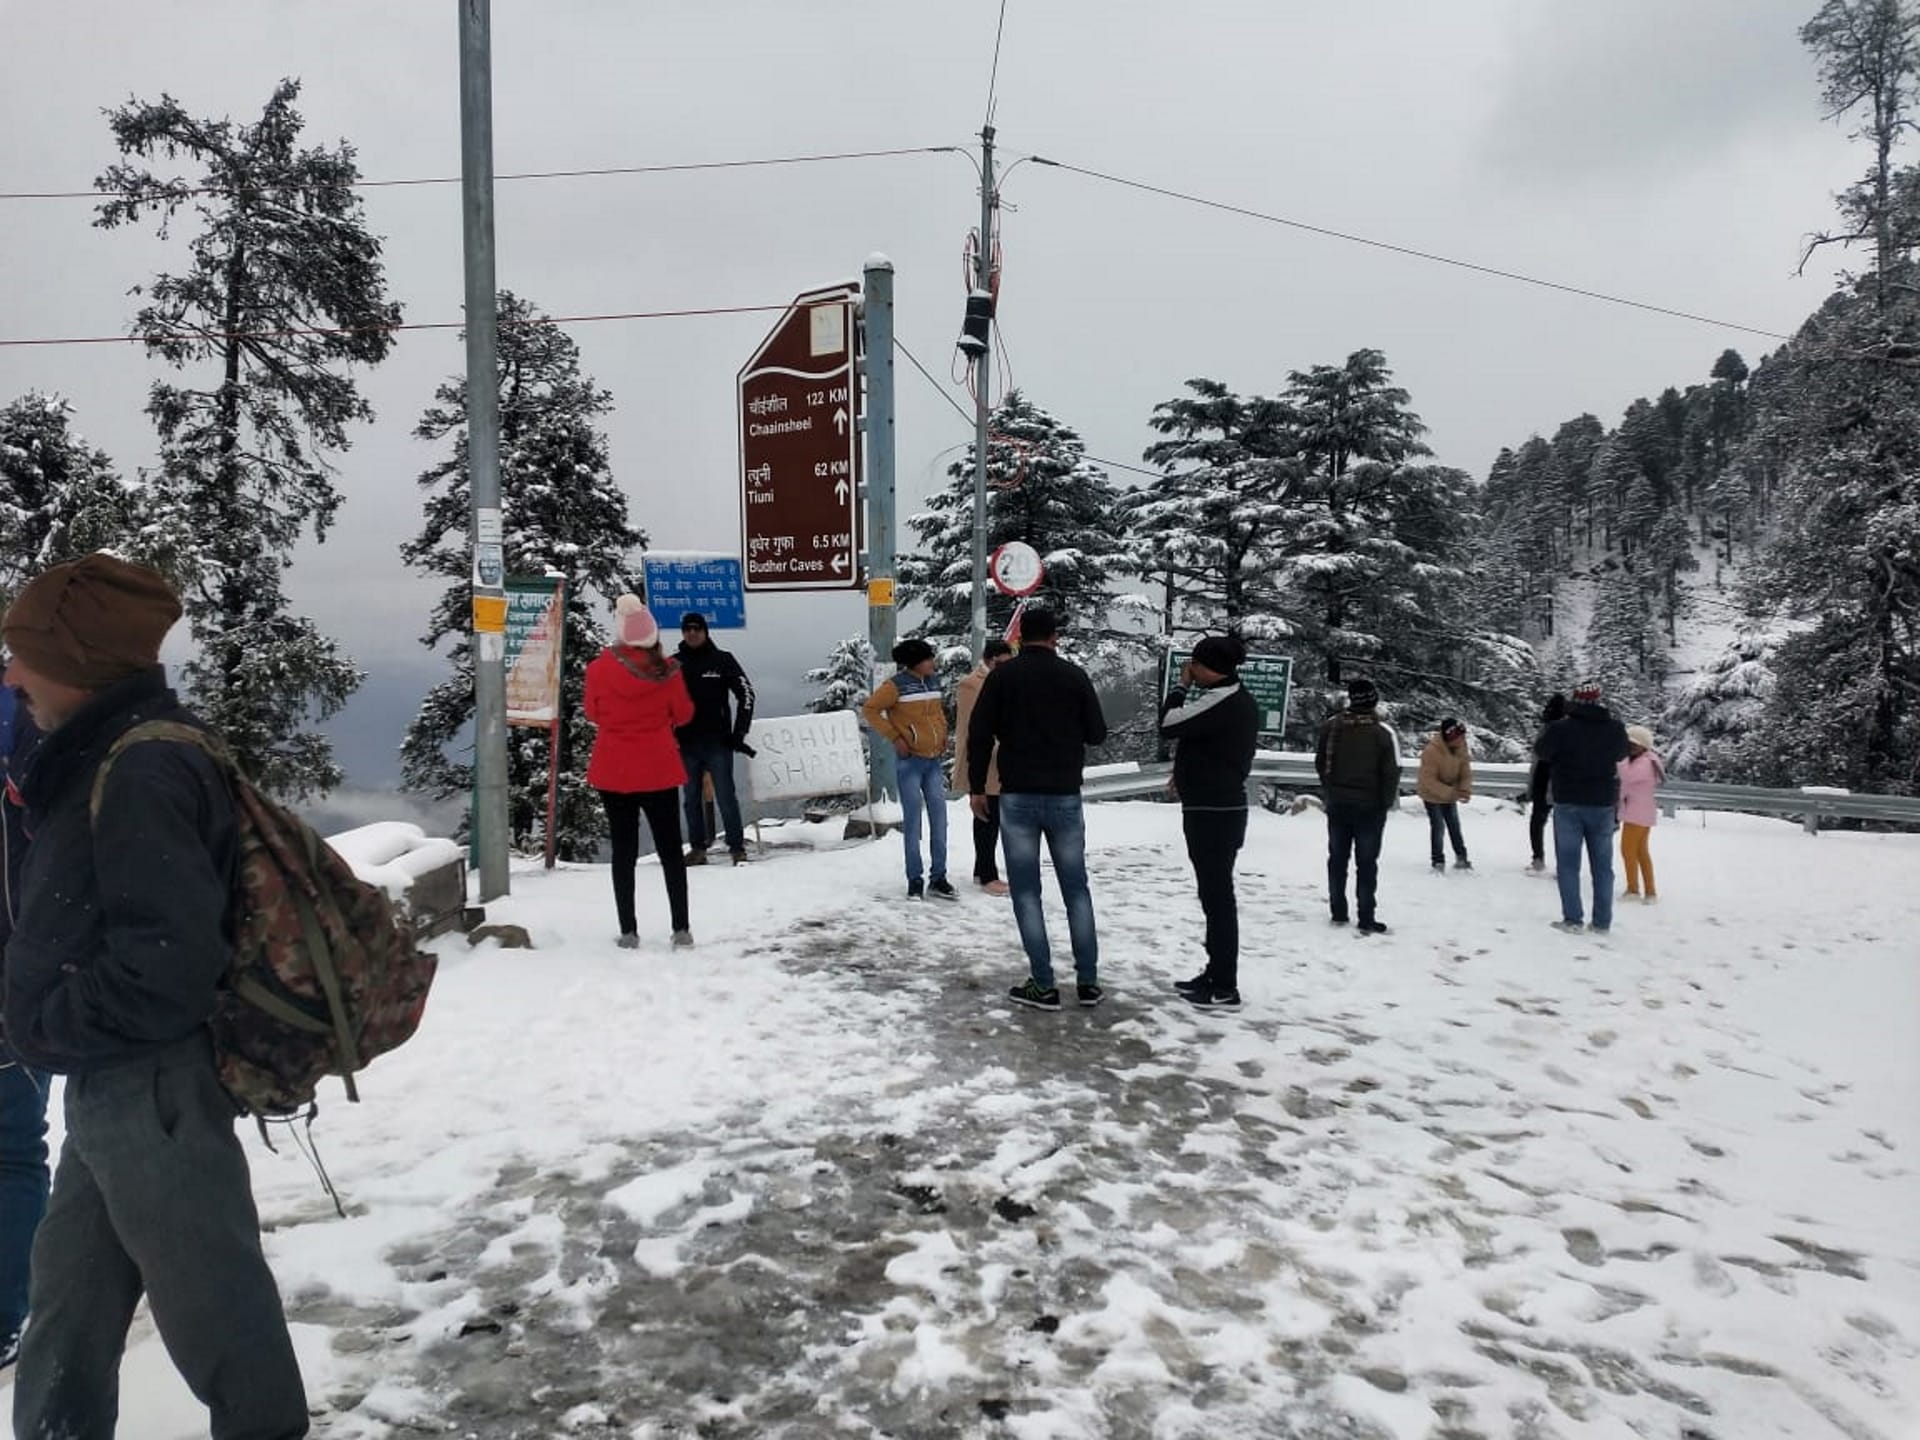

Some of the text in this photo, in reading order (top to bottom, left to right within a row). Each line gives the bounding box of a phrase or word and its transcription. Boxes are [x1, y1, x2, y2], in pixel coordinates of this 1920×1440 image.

[806, 387, 848, 407] 122 KM
[814, 460, 849, 476] 62 KM
[747, 488, 774, 504] Tiuni
[772, 536, 794, 556] गुफा
[812, 533, 850, 549] 6.5 KM
[749, 558, 824, 573] Budher Caves
